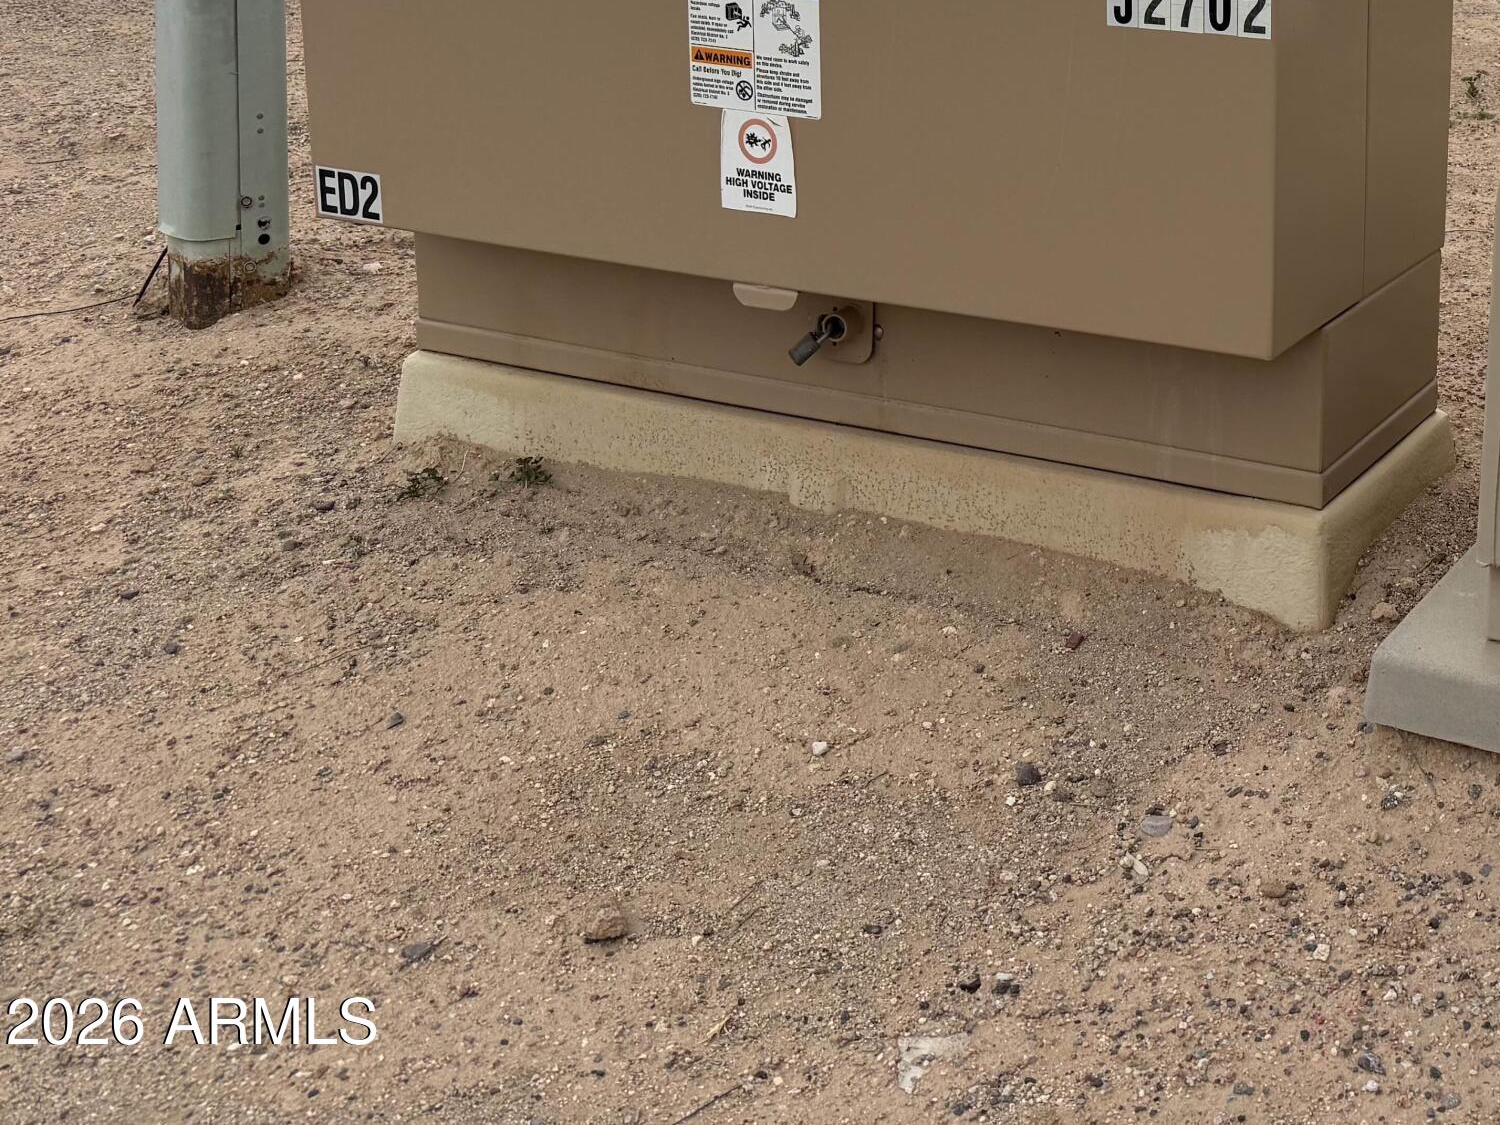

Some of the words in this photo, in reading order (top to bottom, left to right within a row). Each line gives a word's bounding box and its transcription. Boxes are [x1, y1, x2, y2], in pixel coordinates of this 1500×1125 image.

[705, 52, 750, 65] WARNING
[736, 168, 781, 182] WARNING
[725, 176, 748, 187] HIGH
[751, 180, 792, 194] VOLTAGE
[318, 169, 381, 221] ED2
[743, 189, 775, 201] INSIDE
